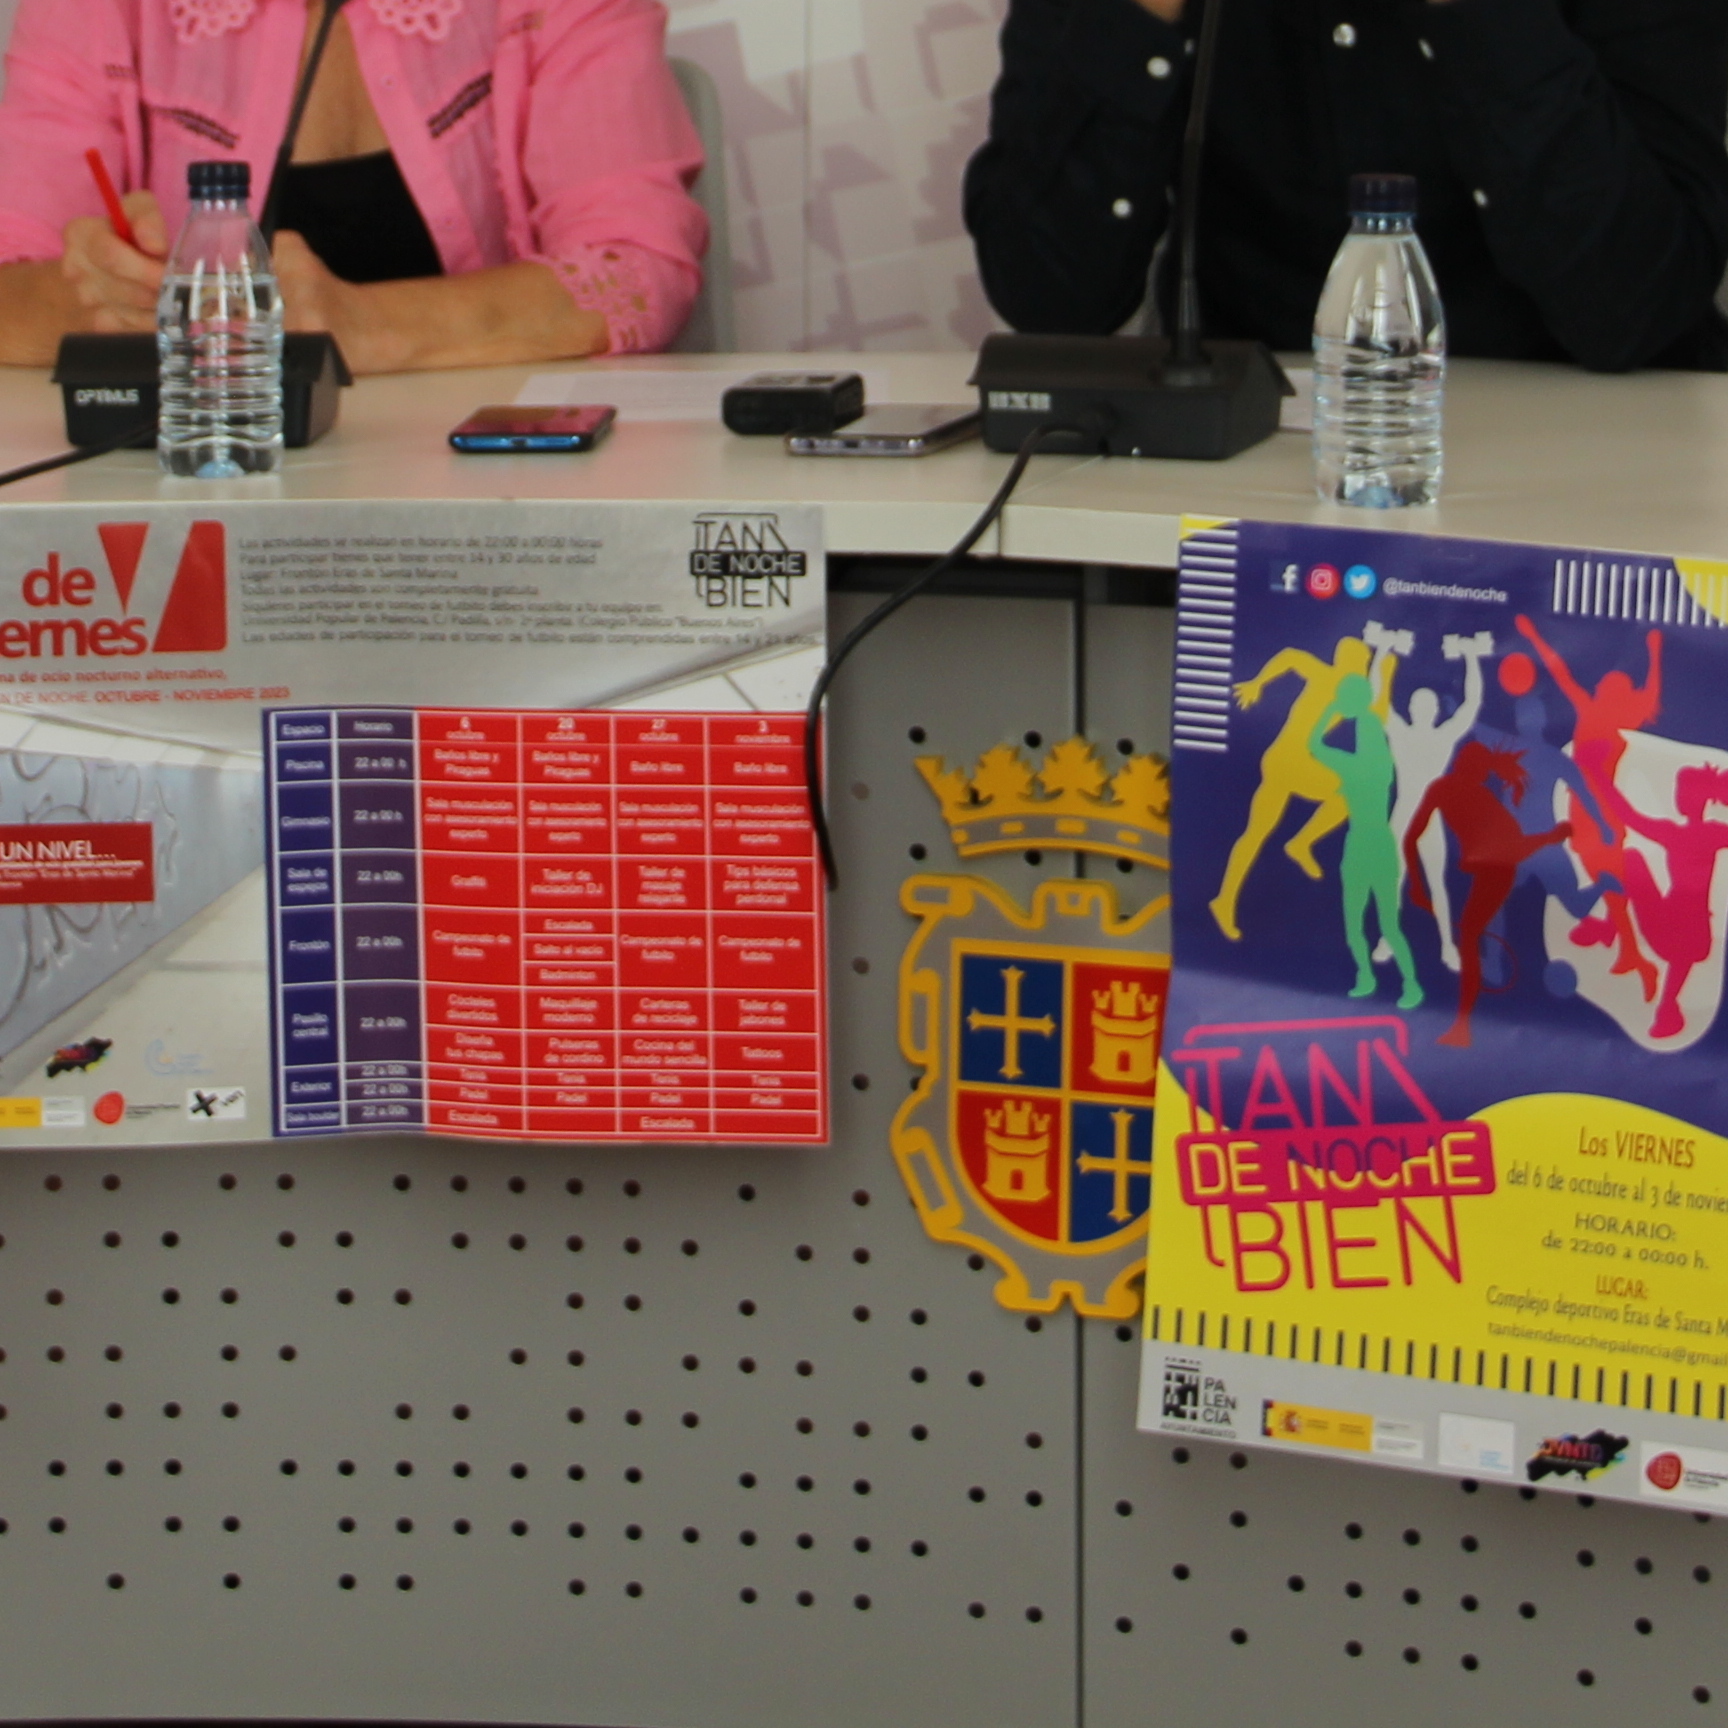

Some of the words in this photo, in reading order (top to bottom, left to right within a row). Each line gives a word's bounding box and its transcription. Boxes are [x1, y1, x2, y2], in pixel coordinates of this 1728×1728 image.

[692, 520, 765, 552] TAN
[693, 552, 723, 573] DE
[730, 552, 803, 573] NOCHE
[21, 551, 97, 608] de
[706, 575, 791, 608] BIEN
[1382, 577, 1509, 602] @tanbiendenoche
[94, 689, 162, 703] OCTUBRE
[173, 687, 256, 702] NOVIEMBRE
[259, 686, 291, 700] 2023
[1171, 1038, 1376, 1134] TAN
[1578, 1125, 1608, 1157] Los
[1615, 1130, 1696, 1168] VIERNES
[1187, 1139, 1268, 1196] DE
[1285, 1131, 1482, 1192] NOCHE
[1506, 1159, 1528, 1187] del
[1532, 1165, 1542, 1189] 6
[1546, 1164, 1564, 1191] de
[1568, 1171, 1627, 1200] octubre
[1632, 1177, 1646, 1202] al
[1650, 1185, 1660, 1208] 3
[1663, 1180, 1681, 1207] de
[1574, 1212, 1677, 1242] HORARIO:
[1228, 1195, 1464, 1292] BIEN
[1541, 1229, 1563, 1250] de
[1569, 1237, 1617, 1257] 22:00
[1622, 1246, 1633, 1259] a
[1638, 1247, 1688, 1267] 00:00
[1693, 1249, 1710, 1270] h.
[1595, 1274, 1649, 1300] LUGAR:
[1486, 1284, 1549, 1317] Complejo
[1553, 1289, 1619, 1322] deportivo
[1623, 1303, 1650, 1327] Eras
[1653, 1305, 1671, 1330] de
[1674, 1310, 1712, 1335] Santa
[1203, 1376, 1226, 1392] PA
[1202, 1407, 1233, 1425] CIA
[1203, 1392, 1237, 1411] LEN
